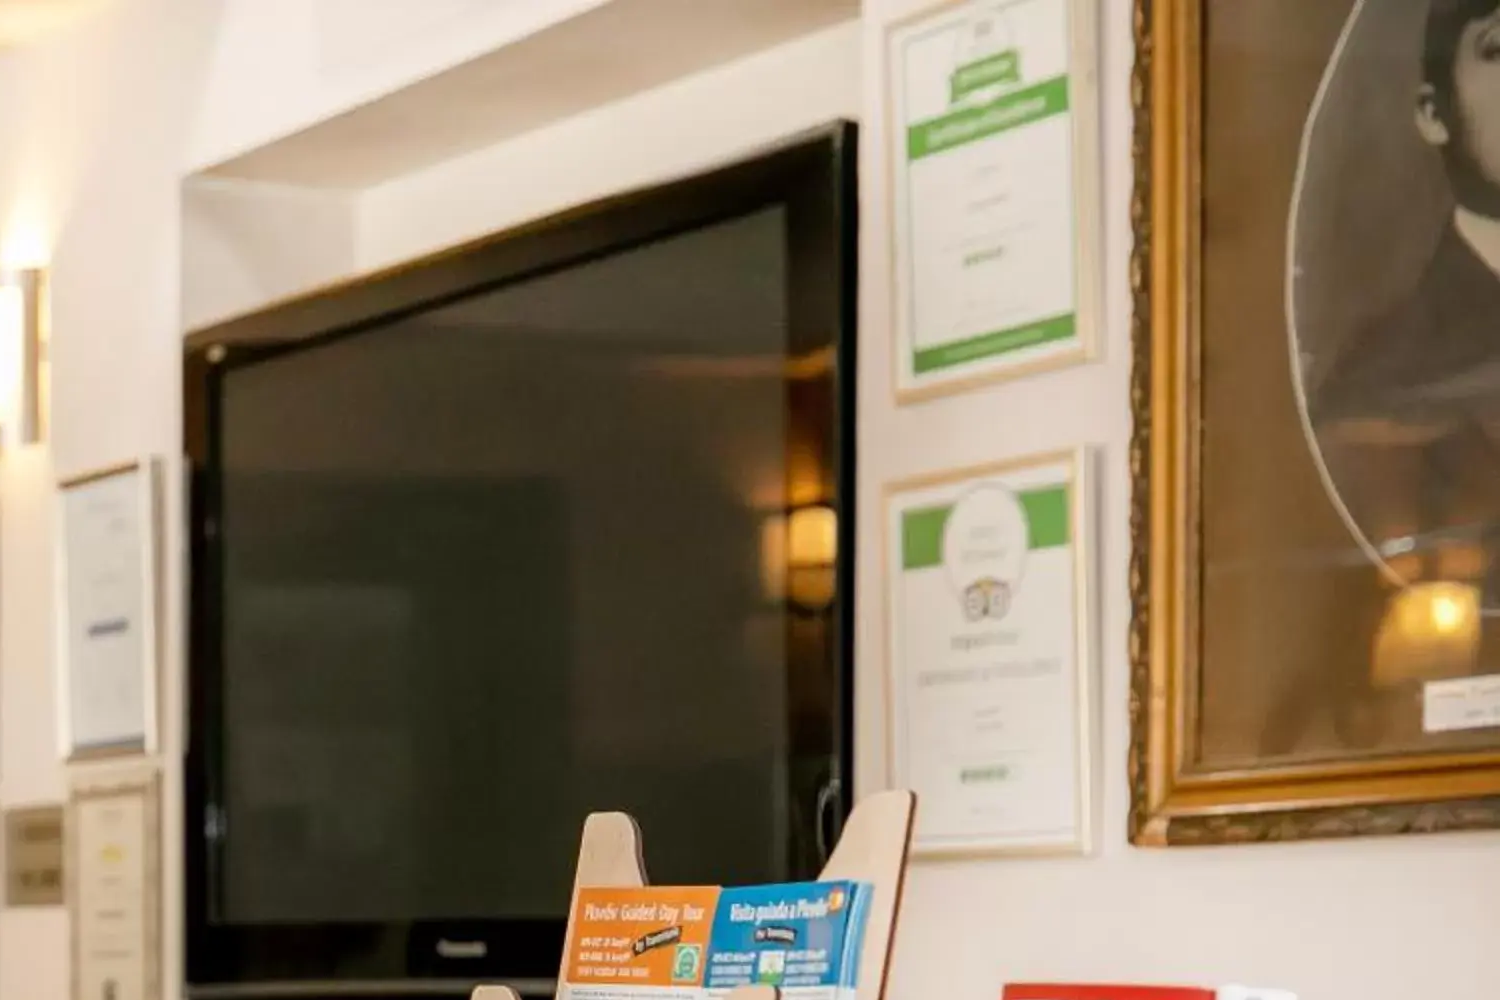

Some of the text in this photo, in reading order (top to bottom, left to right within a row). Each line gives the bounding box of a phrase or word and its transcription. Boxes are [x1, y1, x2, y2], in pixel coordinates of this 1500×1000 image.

[621, 903, 656, 921] Guided
[659, 904, 679, 924] Day
[683, 905, 705, 920] Tour
